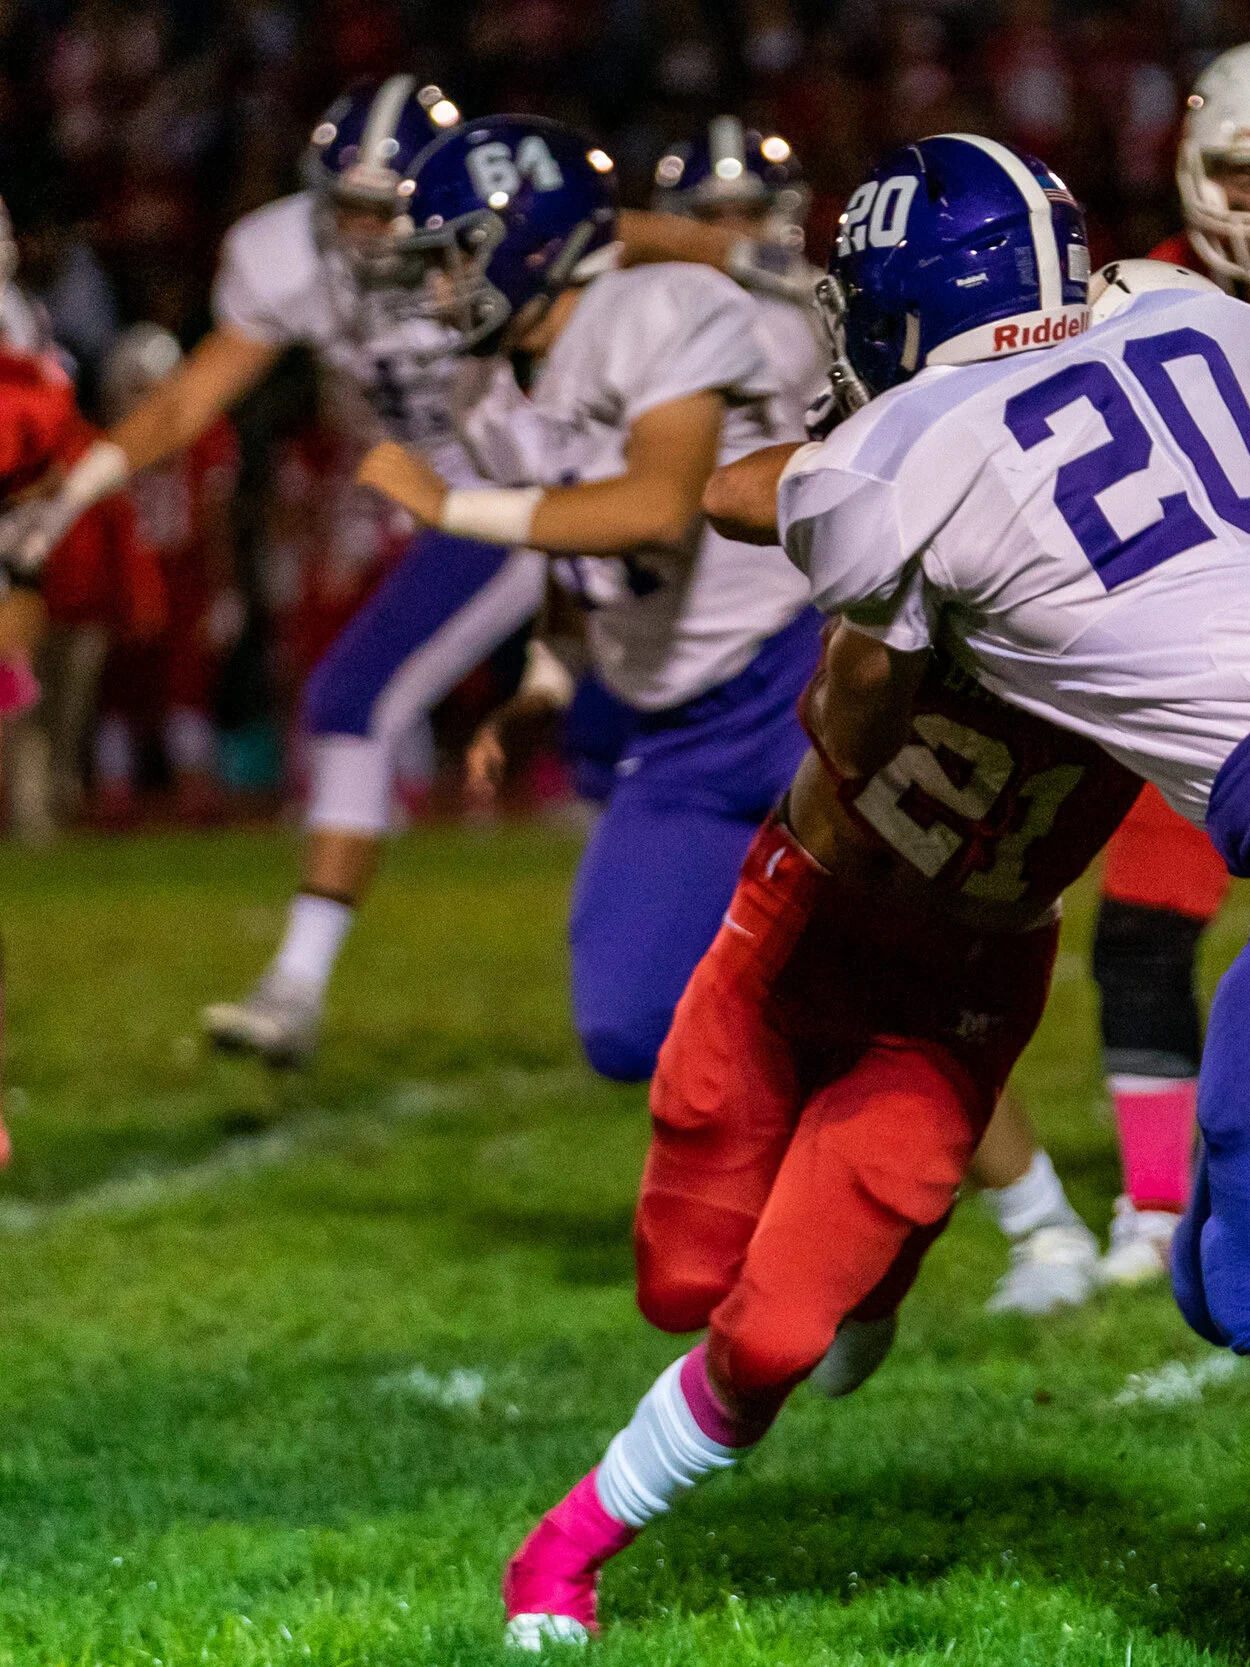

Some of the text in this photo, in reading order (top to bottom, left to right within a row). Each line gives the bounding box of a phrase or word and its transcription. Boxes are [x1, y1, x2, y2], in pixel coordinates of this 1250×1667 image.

[838, 174, 920, 257] 20
[992, 309, 1091, 353] Riddell
[852, 713, 1087, 901] 21
